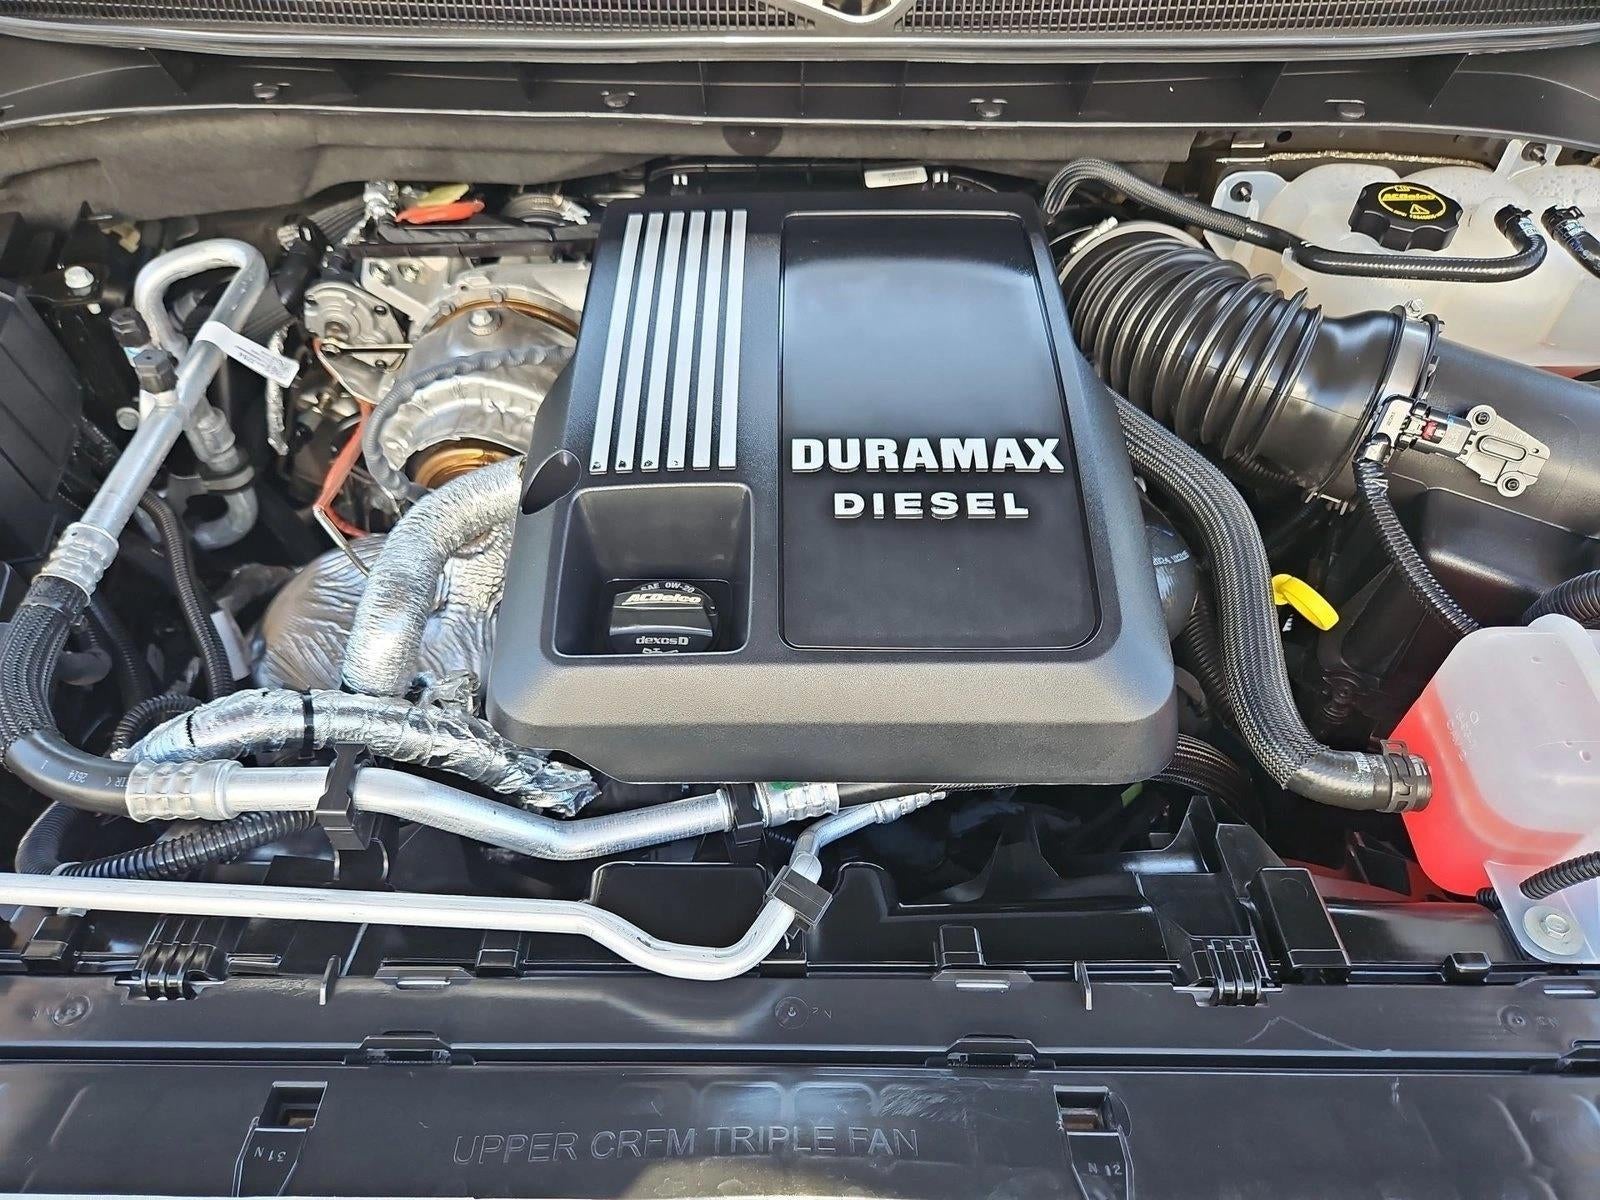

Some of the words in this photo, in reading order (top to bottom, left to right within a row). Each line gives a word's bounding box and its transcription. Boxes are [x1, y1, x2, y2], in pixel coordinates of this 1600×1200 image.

[792, 438, 1064, 473] DURAMAX
[834, 492, 1029, 519] DIESEL
[622, 593, 702, 605] ACDelco
[453, 1132, 579, 1165] UPPER
[590, 1128, 696, 1160] CRFM
[708, 1125, 836, 1153] TRIPLE
[849, 1126, 919, 1160] FAN
